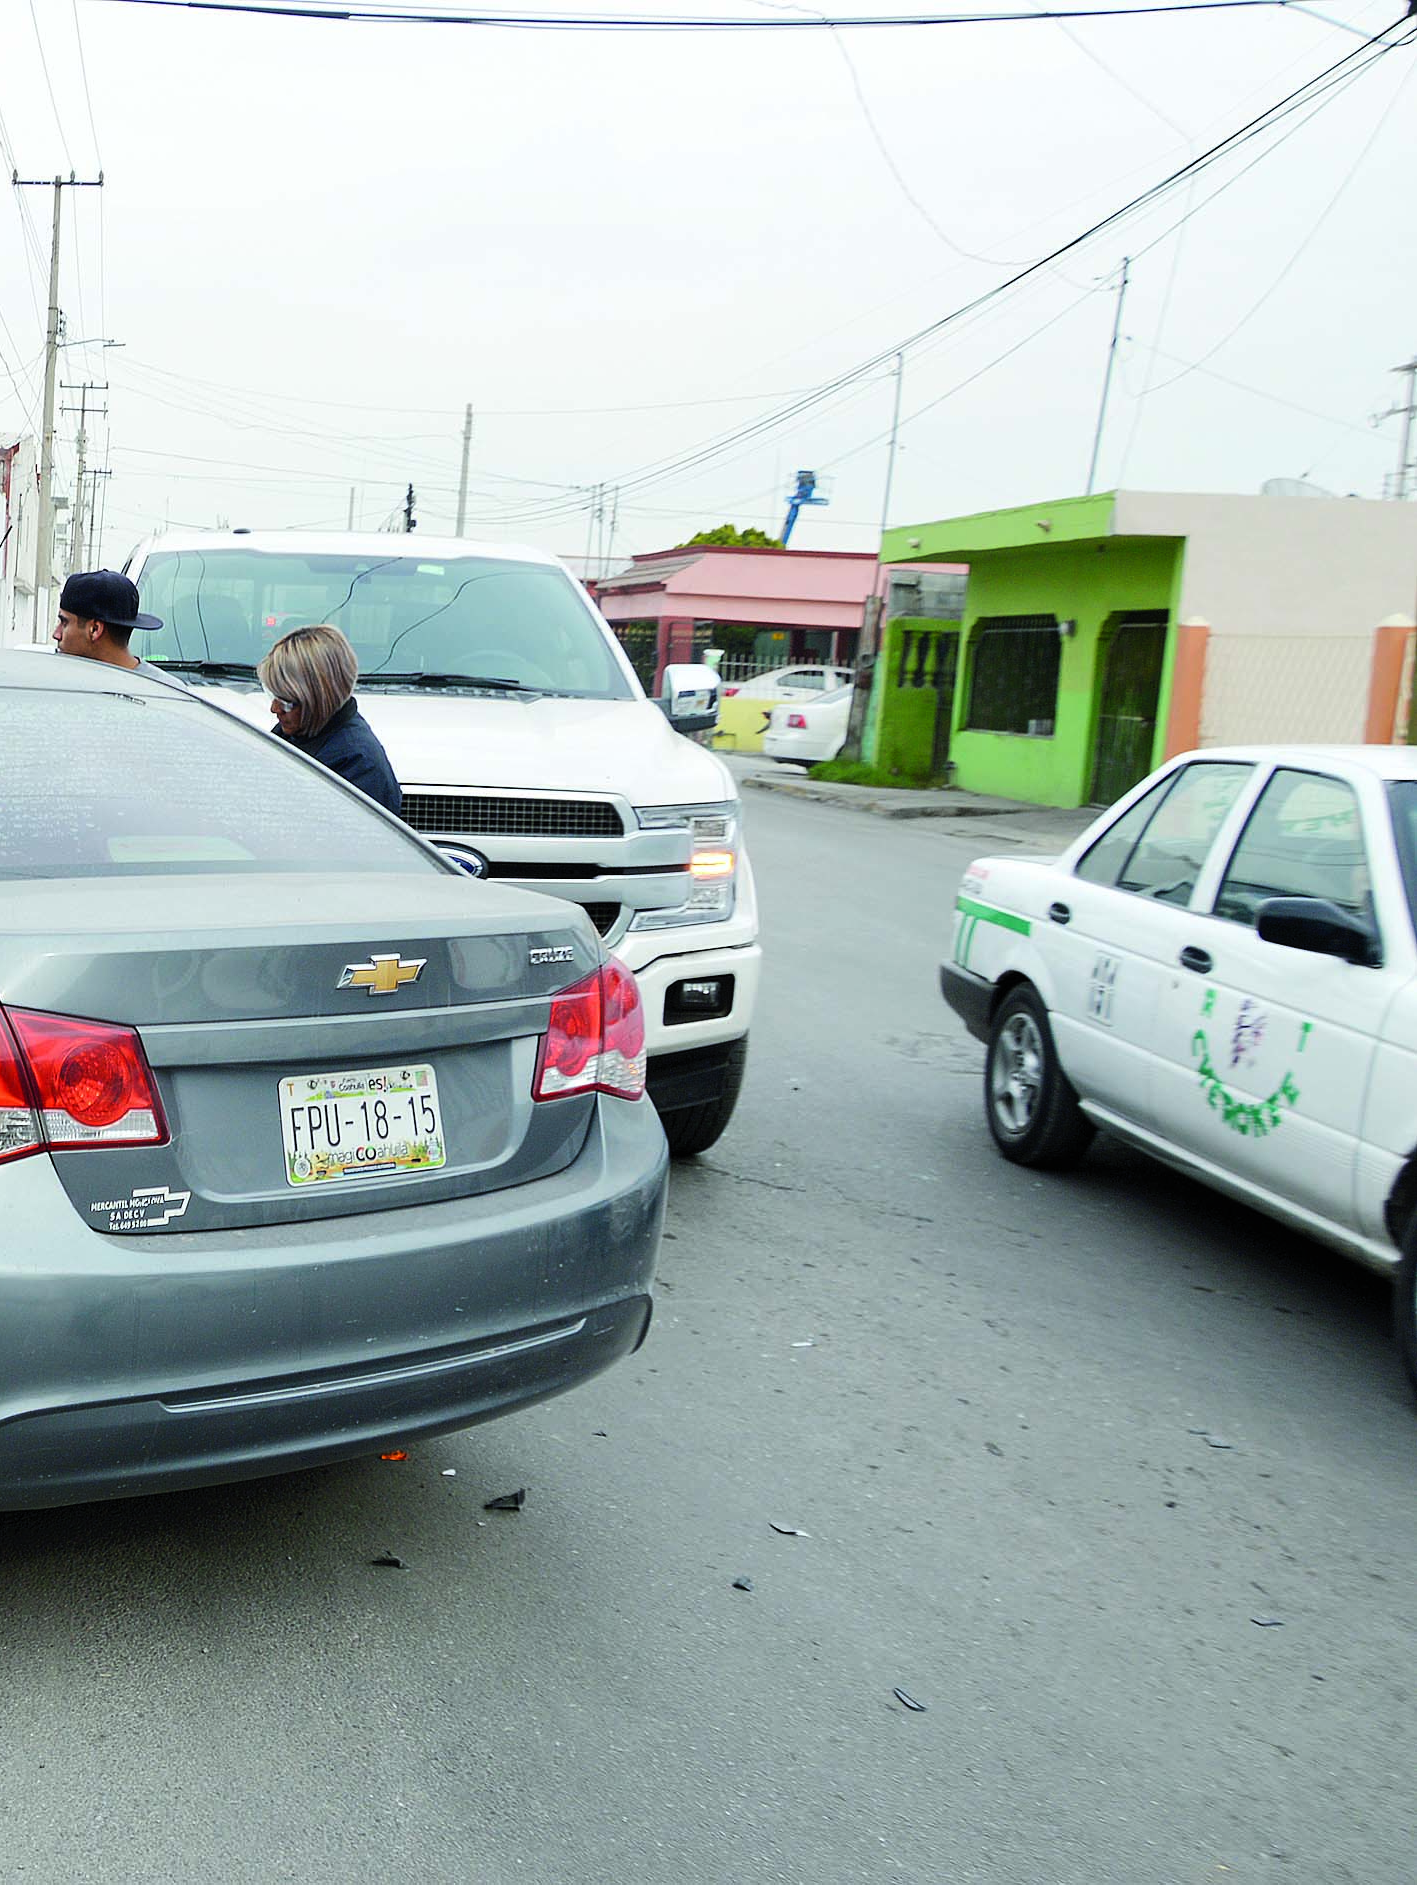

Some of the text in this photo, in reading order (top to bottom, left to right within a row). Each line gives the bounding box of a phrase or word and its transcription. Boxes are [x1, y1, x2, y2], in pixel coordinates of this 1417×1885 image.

[530, 946, 574, 964] CRUZE
[290, 1094, 436, 1152] FPU-18-15
[91, 1200, 129, 1212] MERCANTIL
